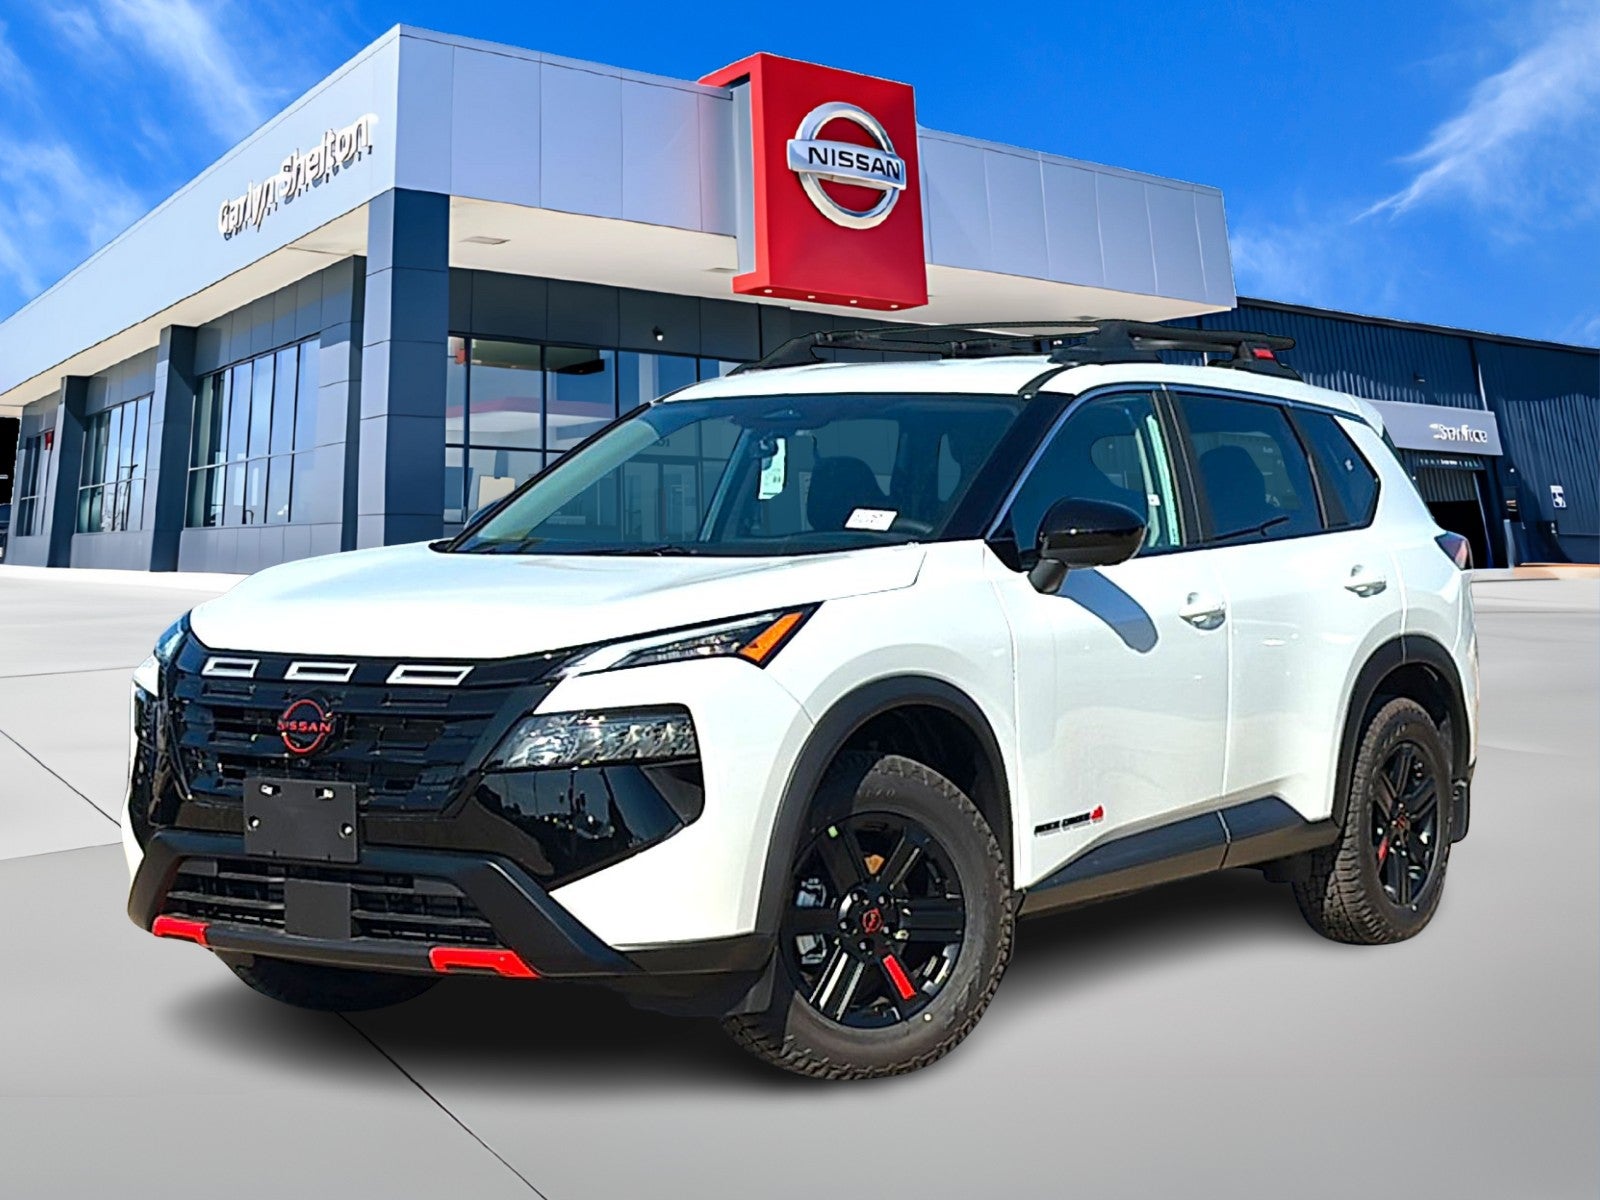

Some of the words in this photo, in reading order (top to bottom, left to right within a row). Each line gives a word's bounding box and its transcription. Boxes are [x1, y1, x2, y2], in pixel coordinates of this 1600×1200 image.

[279, 113, 376, 204] Shelton
[808, 147, 900, 180] NISSAN
[277, 719, 332, 732] NISSAN
